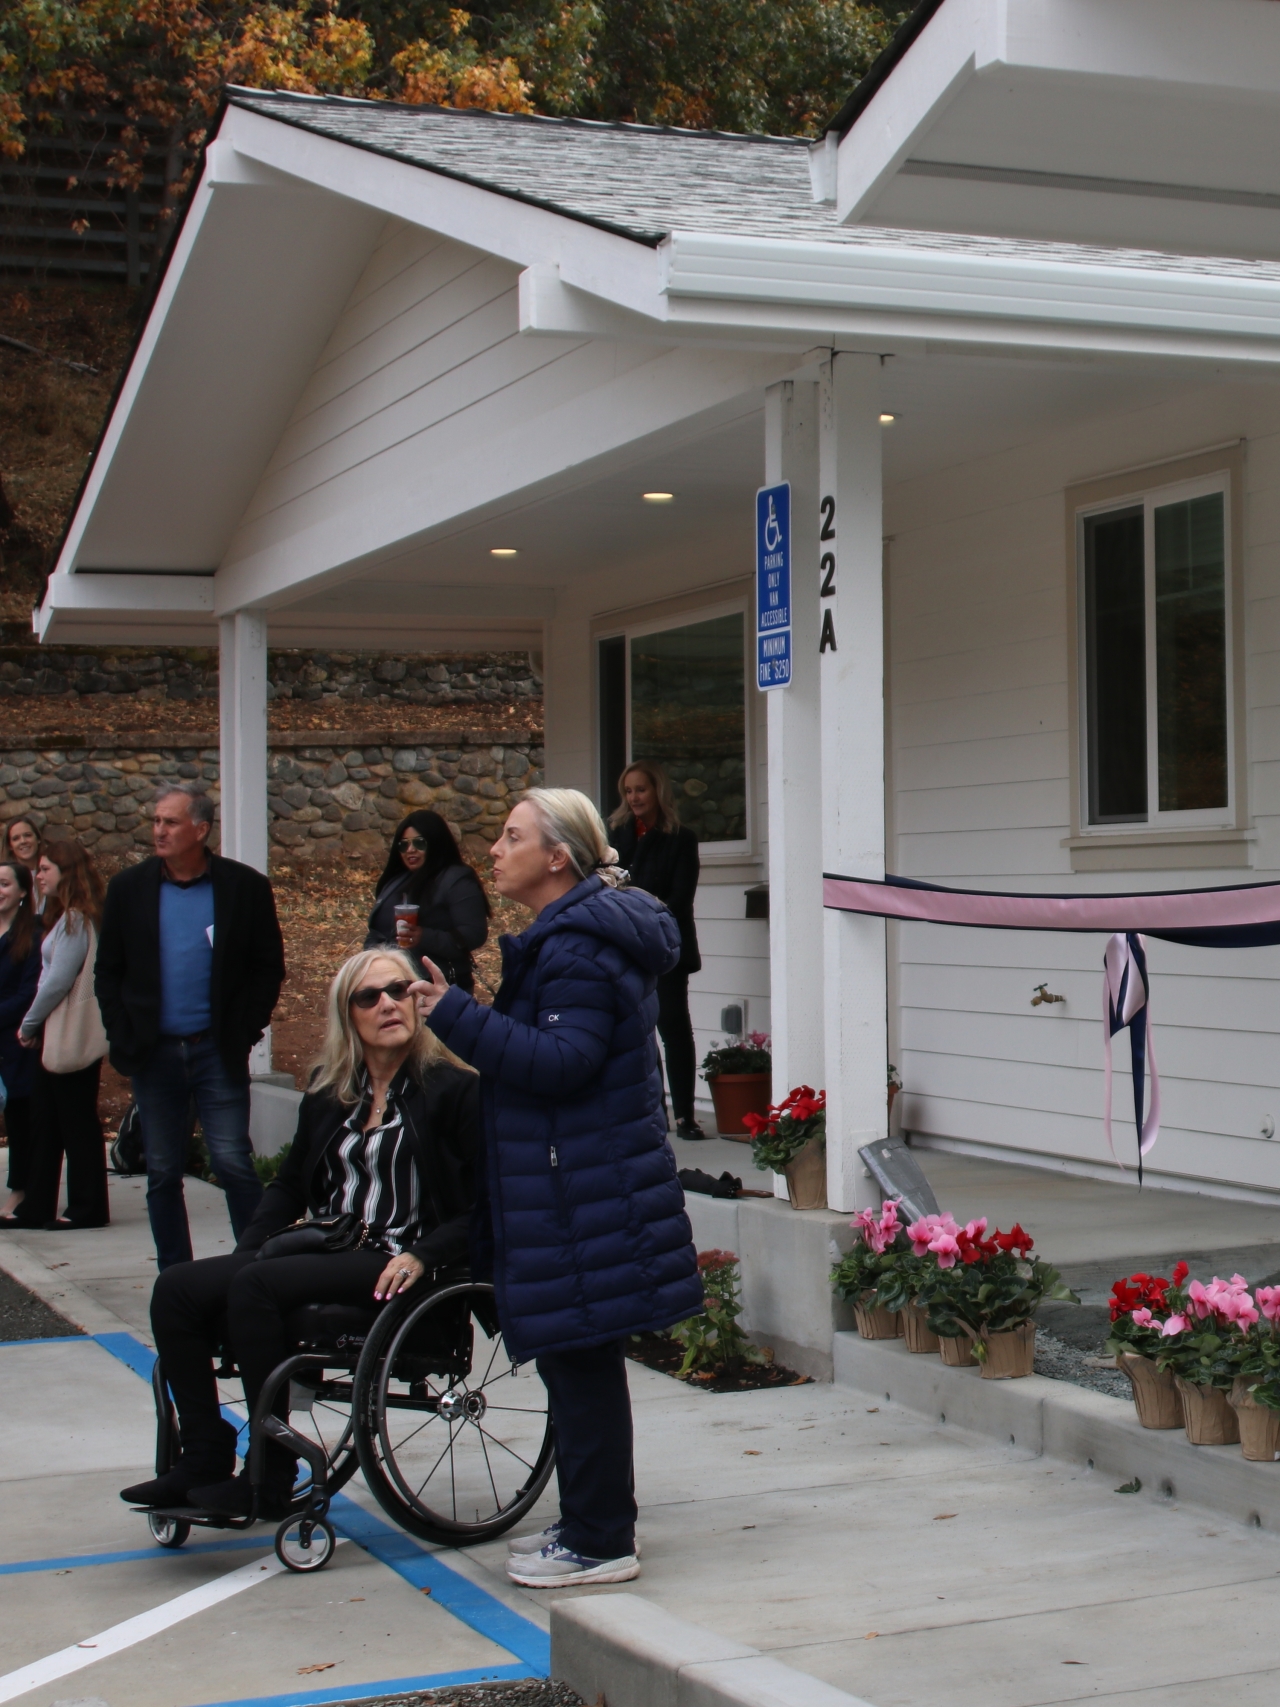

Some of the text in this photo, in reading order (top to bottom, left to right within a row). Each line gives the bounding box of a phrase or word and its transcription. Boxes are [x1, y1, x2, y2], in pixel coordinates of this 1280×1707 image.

[764, 552, 783, 571] PARKING
[767, 571, 780, 589] ONLY
[819, 495, 838, 654] 22A
[769, 590, 779, 607] VAN
[761, 607, 787, 627] ACCESSIBLE
[763, 635, 786, 658] MINIMUM
[760, 658, 790, 682] FINE $250
[548, 1014, 560, 1022] CK
